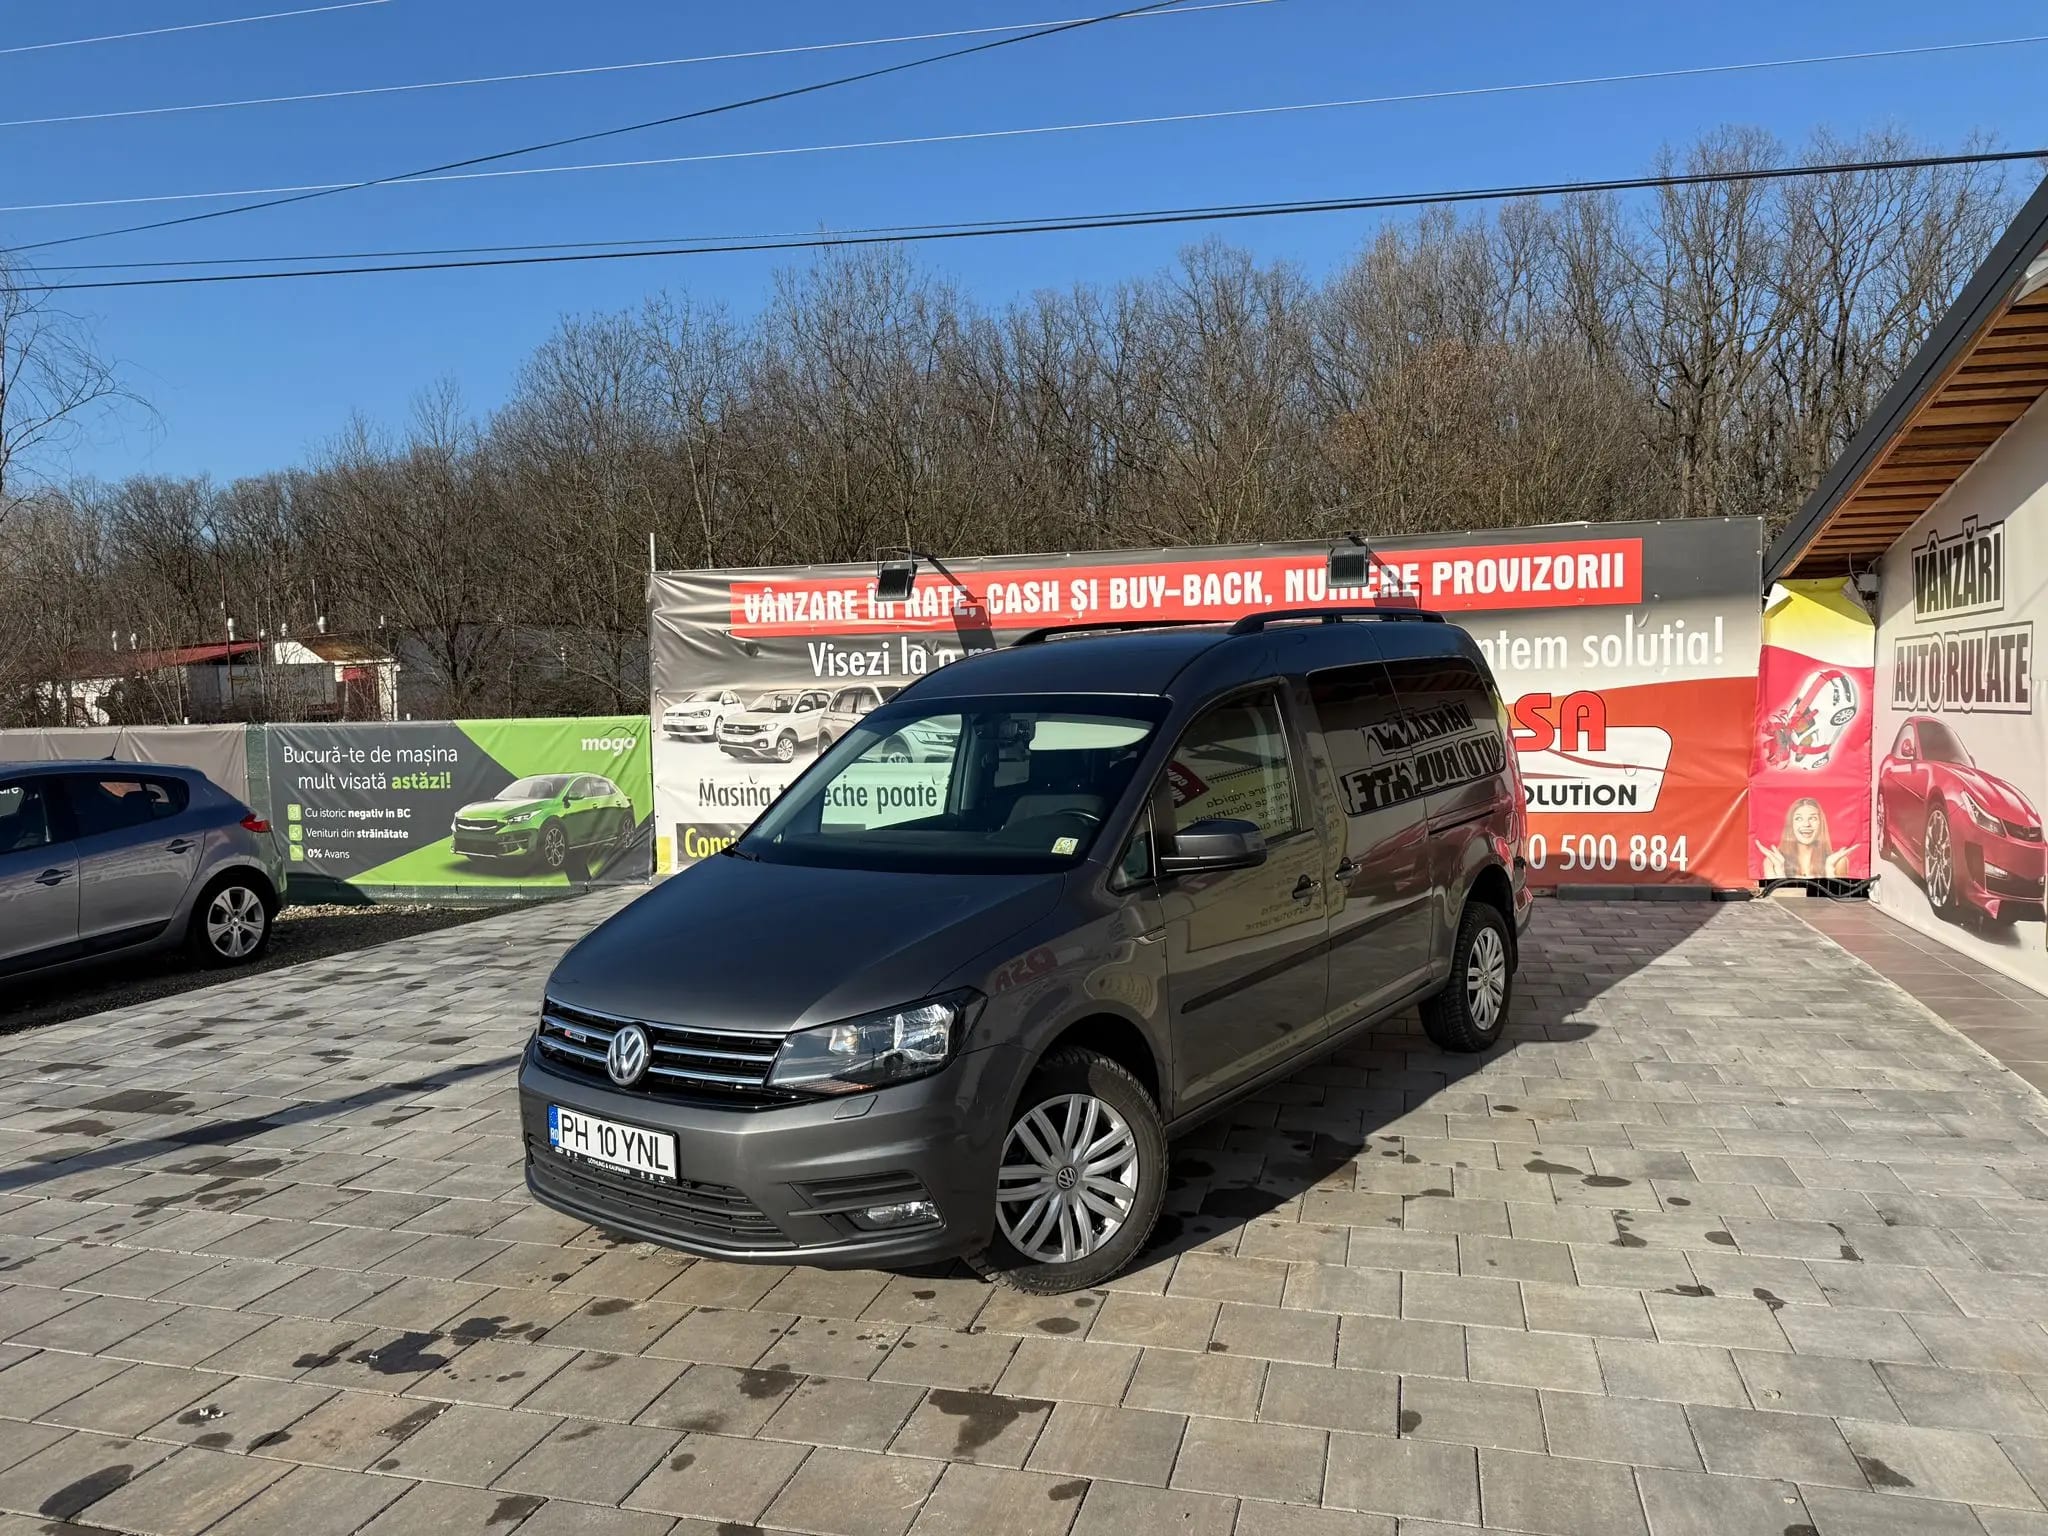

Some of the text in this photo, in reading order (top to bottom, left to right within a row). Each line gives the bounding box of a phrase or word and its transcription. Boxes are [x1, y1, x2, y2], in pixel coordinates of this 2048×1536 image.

[1915, 526, 2001, 614] VÂNZĂRI
[744, 586, 859, 623] VÂNZARE
[904, 584, 977, 619] RATE,
[986, 580, 1067, 615] CASH
[1070, 578, 1098, 618] ȘI
[1110, 571, 1273, 609] BUY-BACK,
[1432, 552, 1625, 597] PROVIZORII
[808, 641, 890, 677] Visezi
[901, 636, 927, 676] la
[1583, 614, 1723, 676] soluția!
[1894, 633, 2029, 703] AUTO RULATE
[284, 745, 458, 767] Bucură-te de mașina
[581, 736, 637, 757] mogo
[298, 772, 452, 790] mult visată astăzi!
[876, 781, 937, 815] poate
[305, 808, 318, 818] Cu
[319, 807, 346, 818] istoric
[348, 808, 384, 820] negativ
[397, 808, 412, 818] BC
[305, 828, 409, 839] Venituri din străinătate
[307, 848, 350, 859] 0% Avans
[1559, 834, 1618, 872] 500
[1629, 834, 1688, 872] 884
[550, 1127, 559, 1141] RO
[561, 1113, 669, 1171] PH 10 YNL
